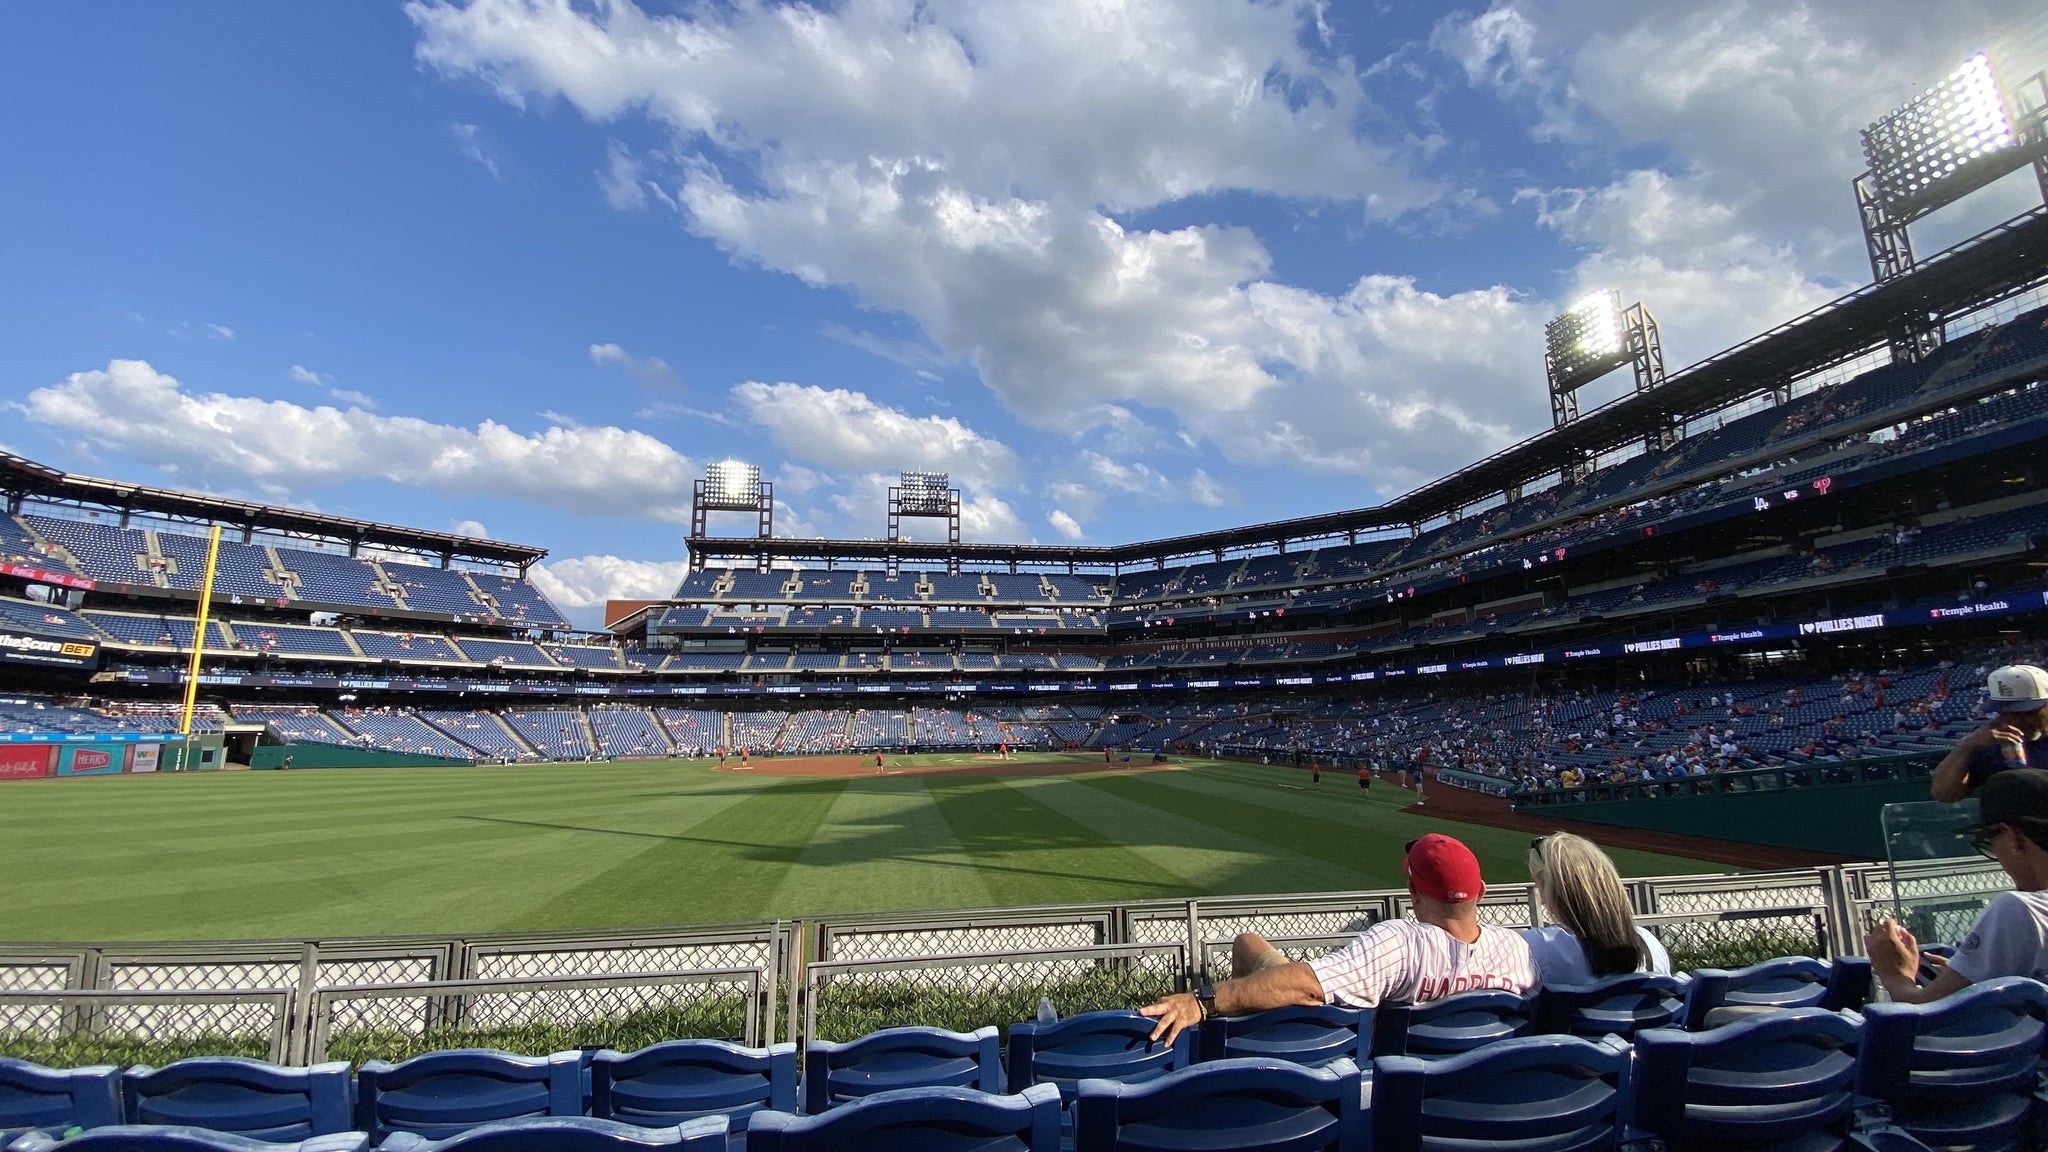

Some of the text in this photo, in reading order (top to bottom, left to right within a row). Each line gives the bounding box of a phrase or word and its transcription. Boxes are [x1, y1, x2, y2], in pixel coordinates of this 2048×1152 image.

[1754, 496, 1769, 511] LA
[1523, 558, 1532, 569] LA
[231, 594, 243, 604] LA
[1940, 605, 1974, 616] Temple
[1975, 600, 2008, 612] Health
[1814, 618, 1854, 633] PHILLIES
[1854, 614, 1884, 628] NIGHT
[1718, 632, 1740, 642] Temple
[1741, 630, 1763, 638] Health
[0, 635, 92, 655] theScore BET
[1206, 639, 1254, 648] PHILADELPHIA
[1256, 637, 1288, 646] PHILLIES
[1635, 640, 1660, 652] PHILLIES
[1660, 638, 1680, 650] NIGHT
[1512, 655, 1531, 665] PHILLIES
[1530, 654, 1544, 663] NIGHT
[77, 753, 107, 765] HERR'S
